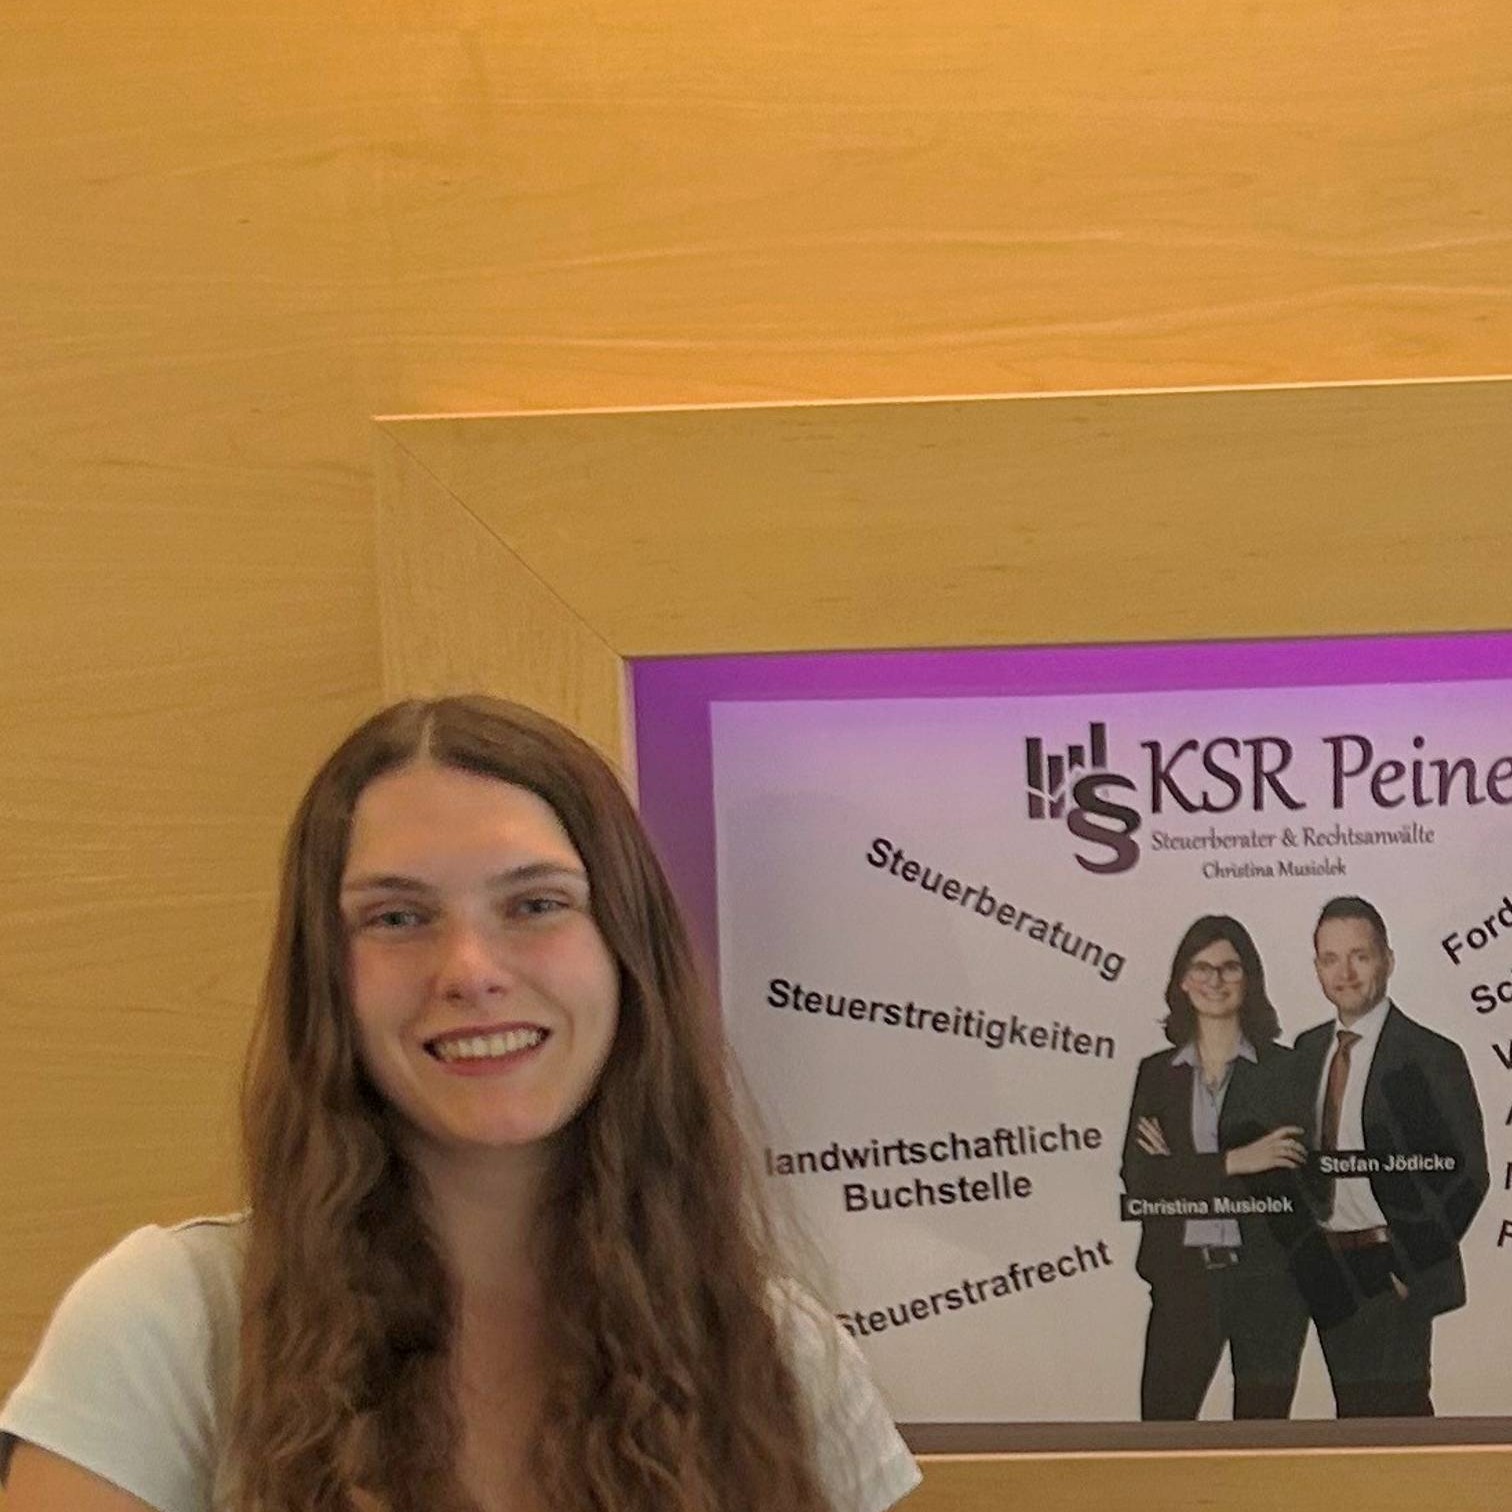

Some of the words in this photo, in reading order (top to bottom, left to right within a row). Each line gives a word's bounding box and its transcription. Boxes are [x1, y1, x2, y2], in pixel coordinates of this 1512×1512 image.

[1140, 736, 1306, 814] KSR
[1151, 827, 1277, 850] Steuerberater
[1281, 828, 1298, 847] &
[1302, 822, 1436, 847] Rechtsanwälte
[1202, 861, 1275, 879] Christina
[1277, 857, 1347, 877] Musiolek
[866, 837, 1127, 981] Steuerberatung
[767, 978, 1116, 1059] Steuerstreitigkeiten
[764, 1123, 1103, 1177] landwirtschaftliche
[1320, 1155, 1379, 1174] Stefan
[1383, 1152, 1456, 1172] Jödicke
[843, 1171, 1033, 1212] Buchstelle
[1127, 1198, 1208, 1217] Christina
[1213, 1196, 1295, 1215] Musiolek
